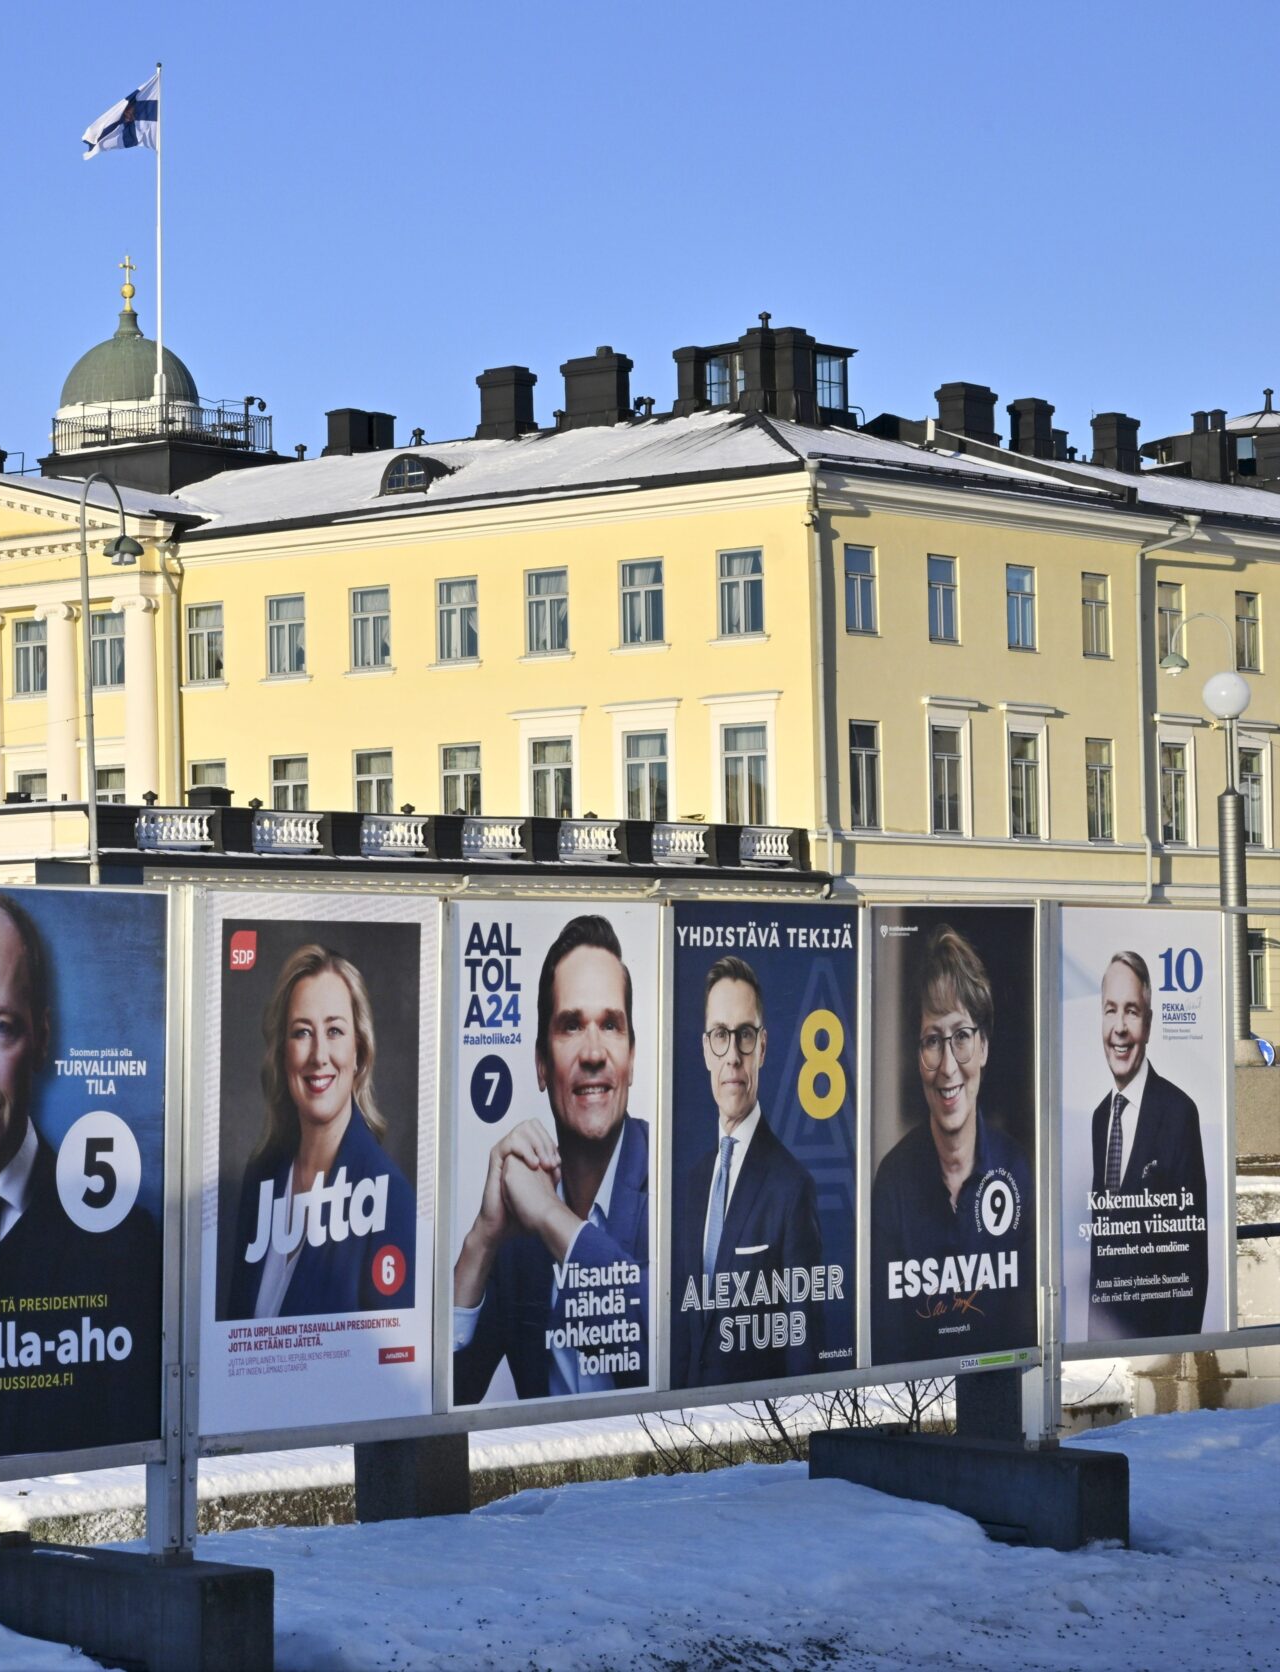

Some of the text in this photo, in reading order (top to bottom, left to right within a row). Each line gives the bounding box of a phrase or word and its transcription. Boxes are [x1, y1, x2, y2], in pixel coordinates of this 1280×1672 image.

[464, 922, 521, 956] AAL
[677, 921, 853, 949] YHDISTÄVÄ TEKIJÄ
[232, 949, 254, 965] SDP
[1158, 947, 1204, 993] 10
[464, 957, 521, 992] TOL
[463, 994, 521, 1028] A24
[1162, 1003, 1185, 1012] PEKKA
[1162, 1013, 1196, 1021] HAAVISTO
[463, 1032, 522, 1045] #aaltoliike24
[55, 1060, 147, 1076] TURVALLINEN
[69, 1048, 132, 1059] Suomen pitää olla
[798, 1009, 846, 1120] 8
[86, 1080, 116, 1095] TILA
[484, 1072, 500, 1106] 7
[81, 1137, 117, 1209] 5
[990, 1189, 1006, 1227] 9
[1087, 1187, 1194, 1211] Kokemuksen ja
[244, 1166, 389, 1264] Jutta
[1078, 1214, 1206, 1241] sydämen viisautta
[1097, 1241, 1190, 1256] Erfarenhet och omdöme
[381, 1255, 395, 1285] 6
[553, 1261, 640, 1290] Viisautta
[888, 1251, 1018, 1300] ESSAYAH
[681, 1264, 844, 1312] ALEXANDER
[19, 1294, 108, 1312] PRESIDENTIKSI
[565, 1289, 626, 1319] nähdä
[228, 1327, 252, 1339] JUTTA
[254, 1323, 297, 1337] URPILAINEN
[299, 1319, 346, 1334] TASAVALLAN
[545, 1318, 640, 1349] rohkeutta
[719, 1311, 806, 1352] STUBB
[228, 1341, 252, 1353] JOTTA
[254, 1337, 283, 1350] KETÄÄN
[284, 1339, 292, 1349] EI
[818, 1347, 853, 1360] alexstubb.fi
[578, 1347, 640, 1376] toimia
[961, 1360, 978, 1369] STARA
